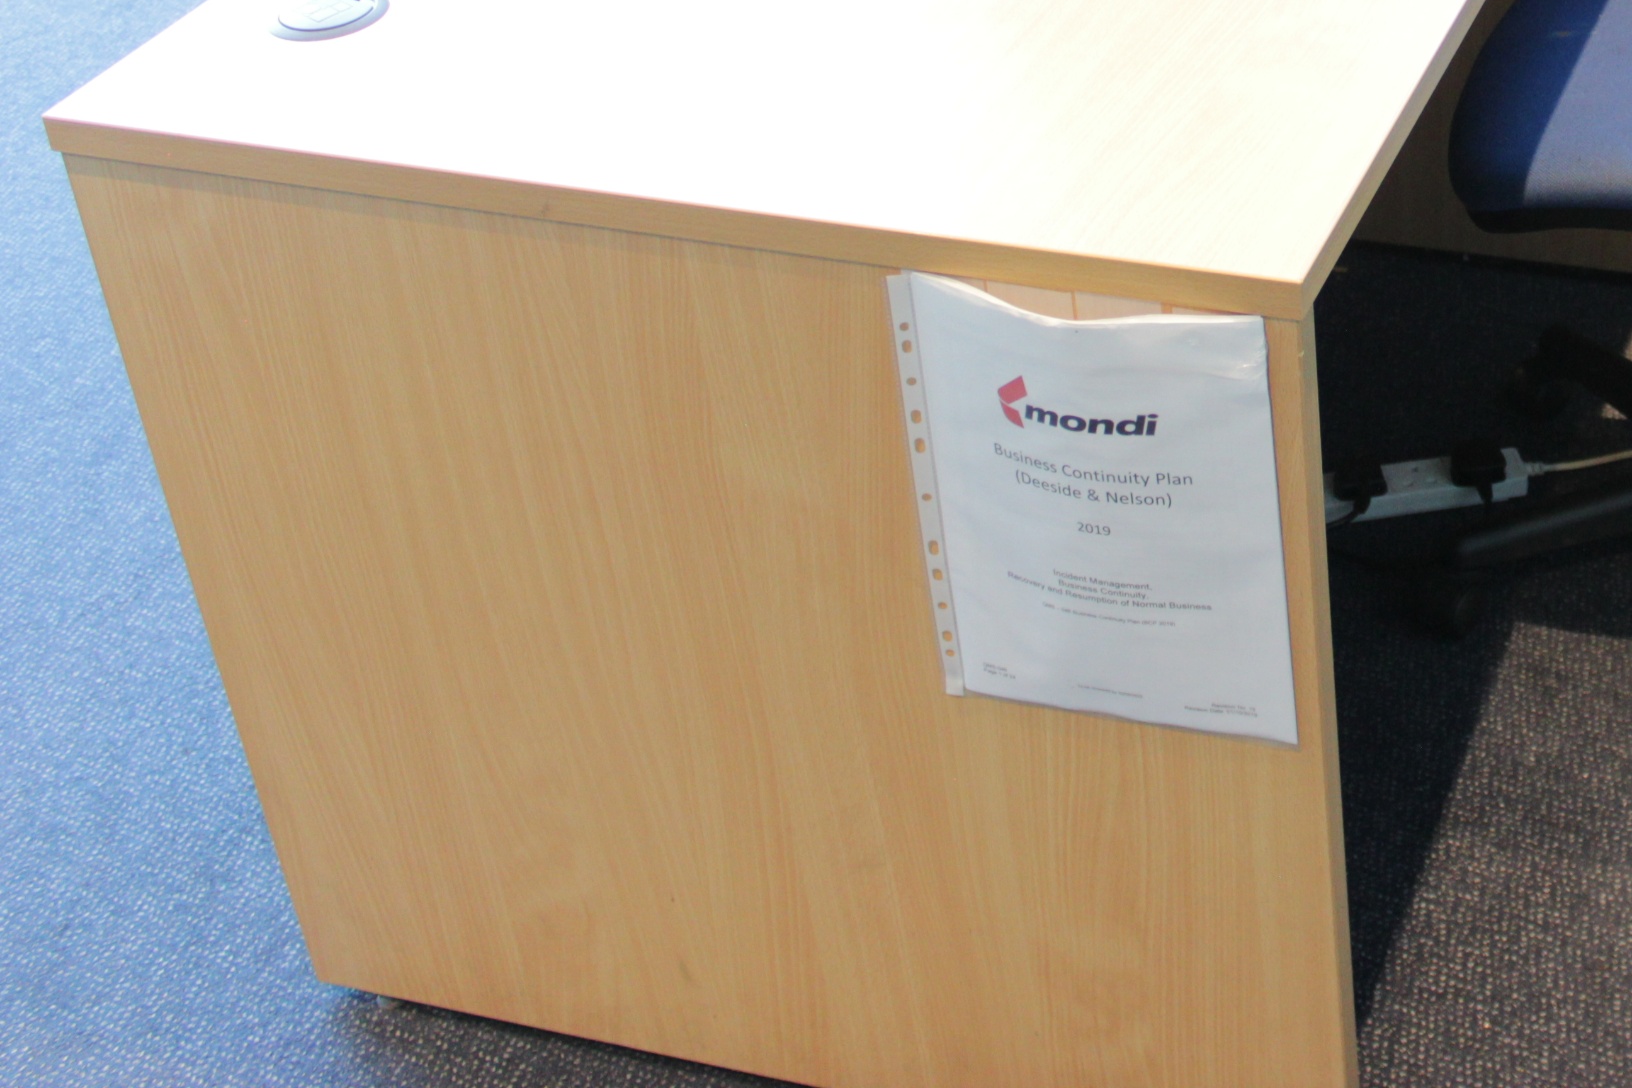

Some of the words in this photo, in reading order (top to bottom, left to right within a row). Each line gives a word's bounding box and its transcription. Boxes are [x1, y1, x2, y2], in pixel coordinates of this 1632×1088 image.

[1025, 404, 1159, 436] mondi
[994, 443, 1057, 473] Business
[1062, 464, 1150, 487] Continuity
[1156, 473, 1193, 486] Plan
[1015, 469, 1081, 499] (Deeside
[1087, 489, 1100, 502] &
[1106, 491, 1172, 508] Nelson)
[1077, 522, 1111, 536] 2019
[1007, 571, 1045, 590] Recovery
[1047, 586, 1063, 595] and
[1065, 590, 1118, 606] Resumption
[1132, 600, 1166, 609] Normal
[1169, 602, 1212, 611] Business
[1053, 568, 1087, 583] Incident
[1058, 579, 1098, 593] Business
